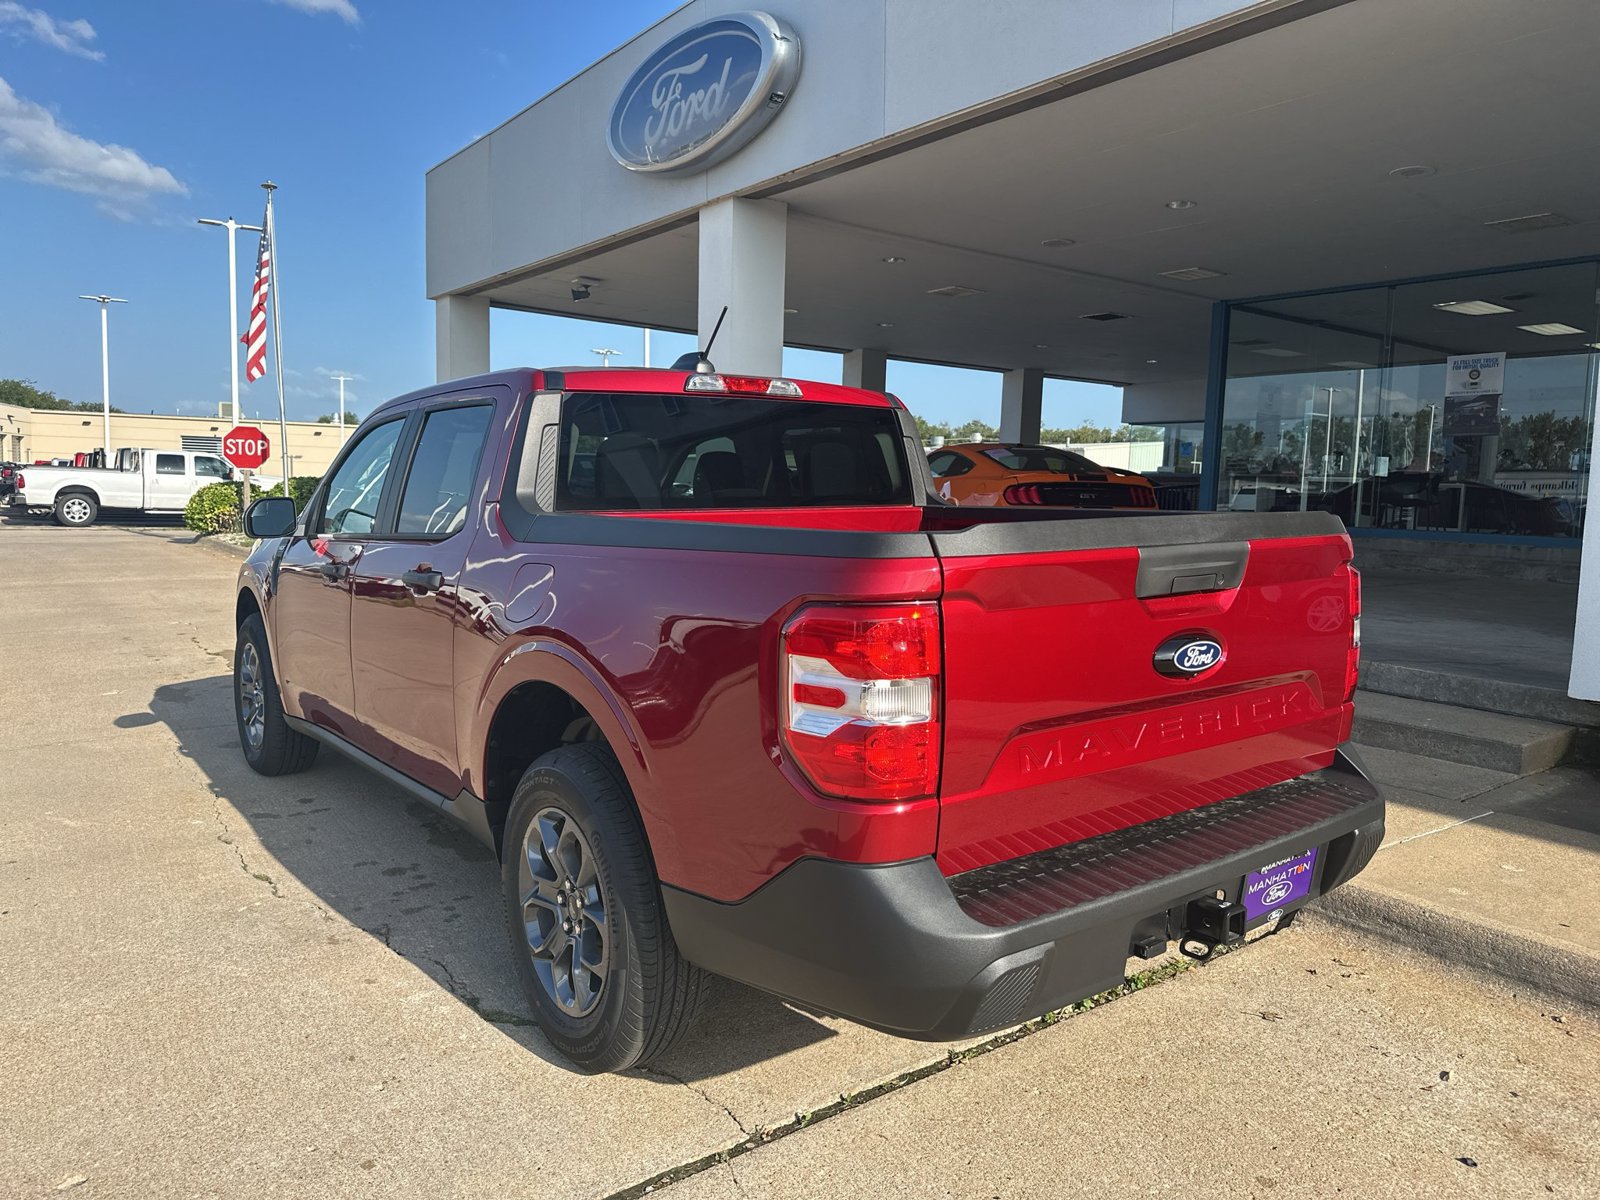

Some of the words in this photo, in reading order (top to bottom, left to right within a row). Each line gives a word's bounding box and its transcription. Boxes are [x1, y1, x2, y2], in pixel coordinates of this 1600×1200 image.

[644, 53, 733, 147] Ford
[225, 438, 268, 456] STOP
[1184, 645, 1215, 667] Ford
[1017, 691, 1302, 775] MAVERICK
[1266, 884, 1288, 903] Ford
